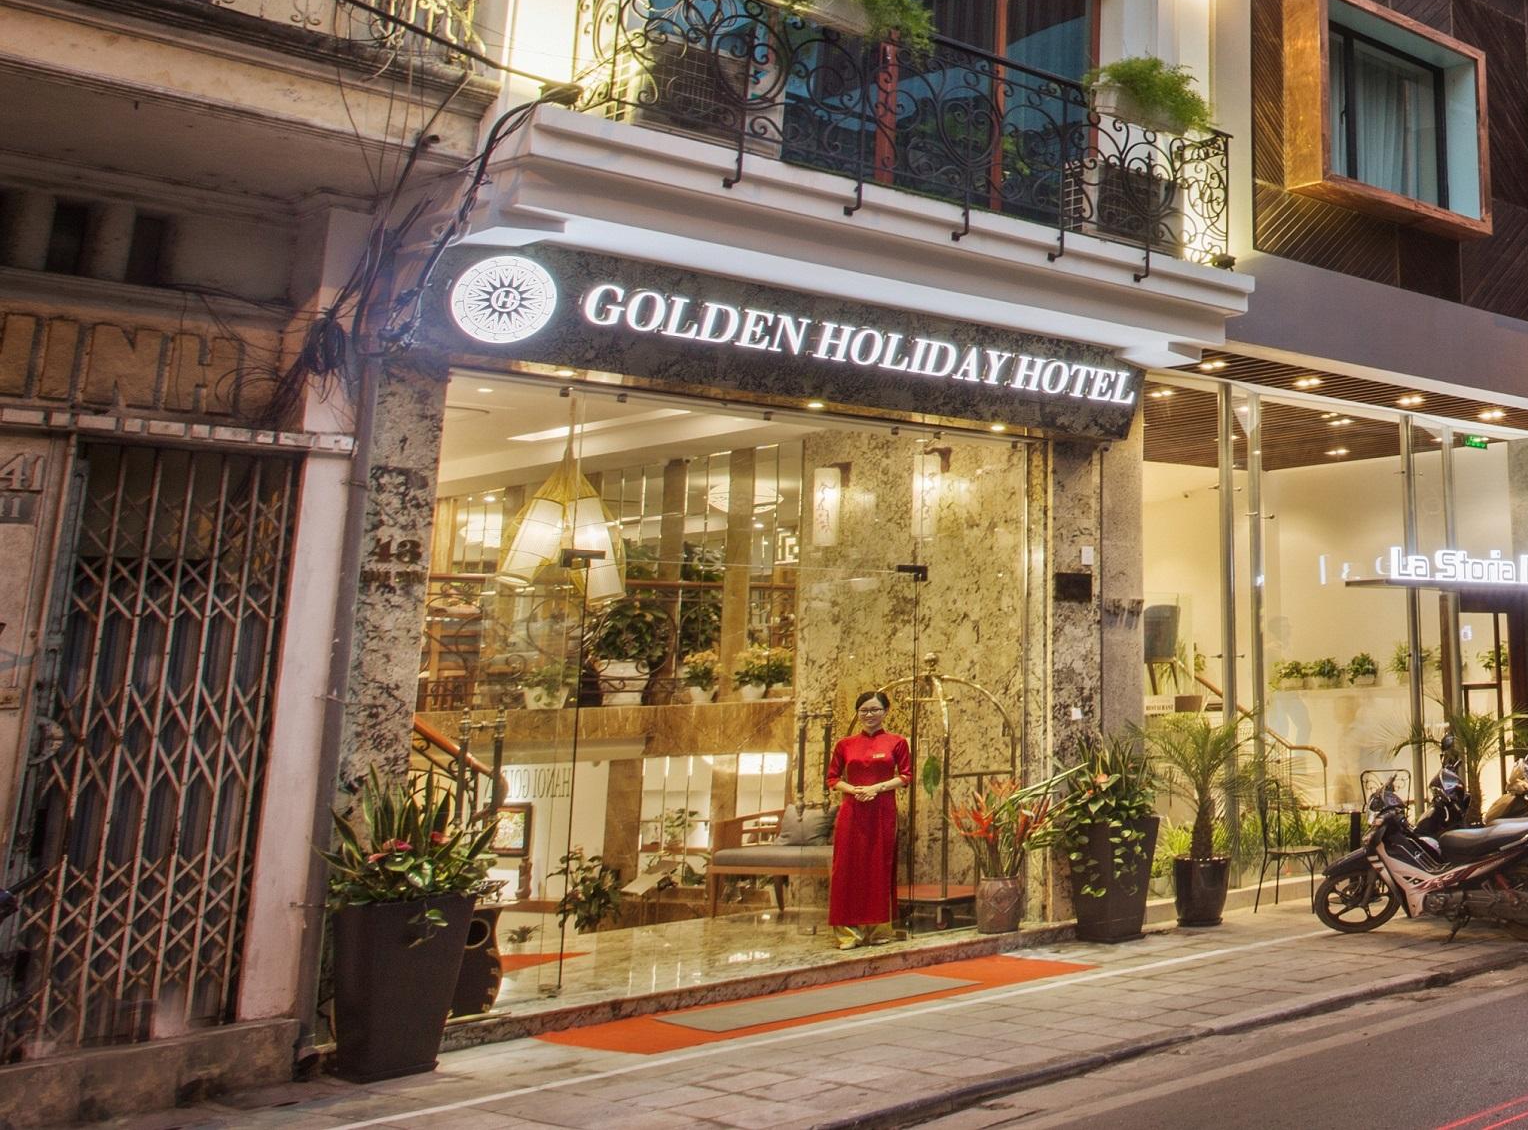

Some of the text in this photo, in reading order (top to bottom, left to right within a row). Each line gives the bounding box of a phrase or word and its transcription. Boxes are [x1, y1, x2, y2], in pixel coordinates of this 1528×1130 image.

[585, 284, 1136, 405] GOLDEN HOLIDAY HOTEL
[1390, 546, 1430, 581] La
[1434, 549, 1516, 583] Storia
